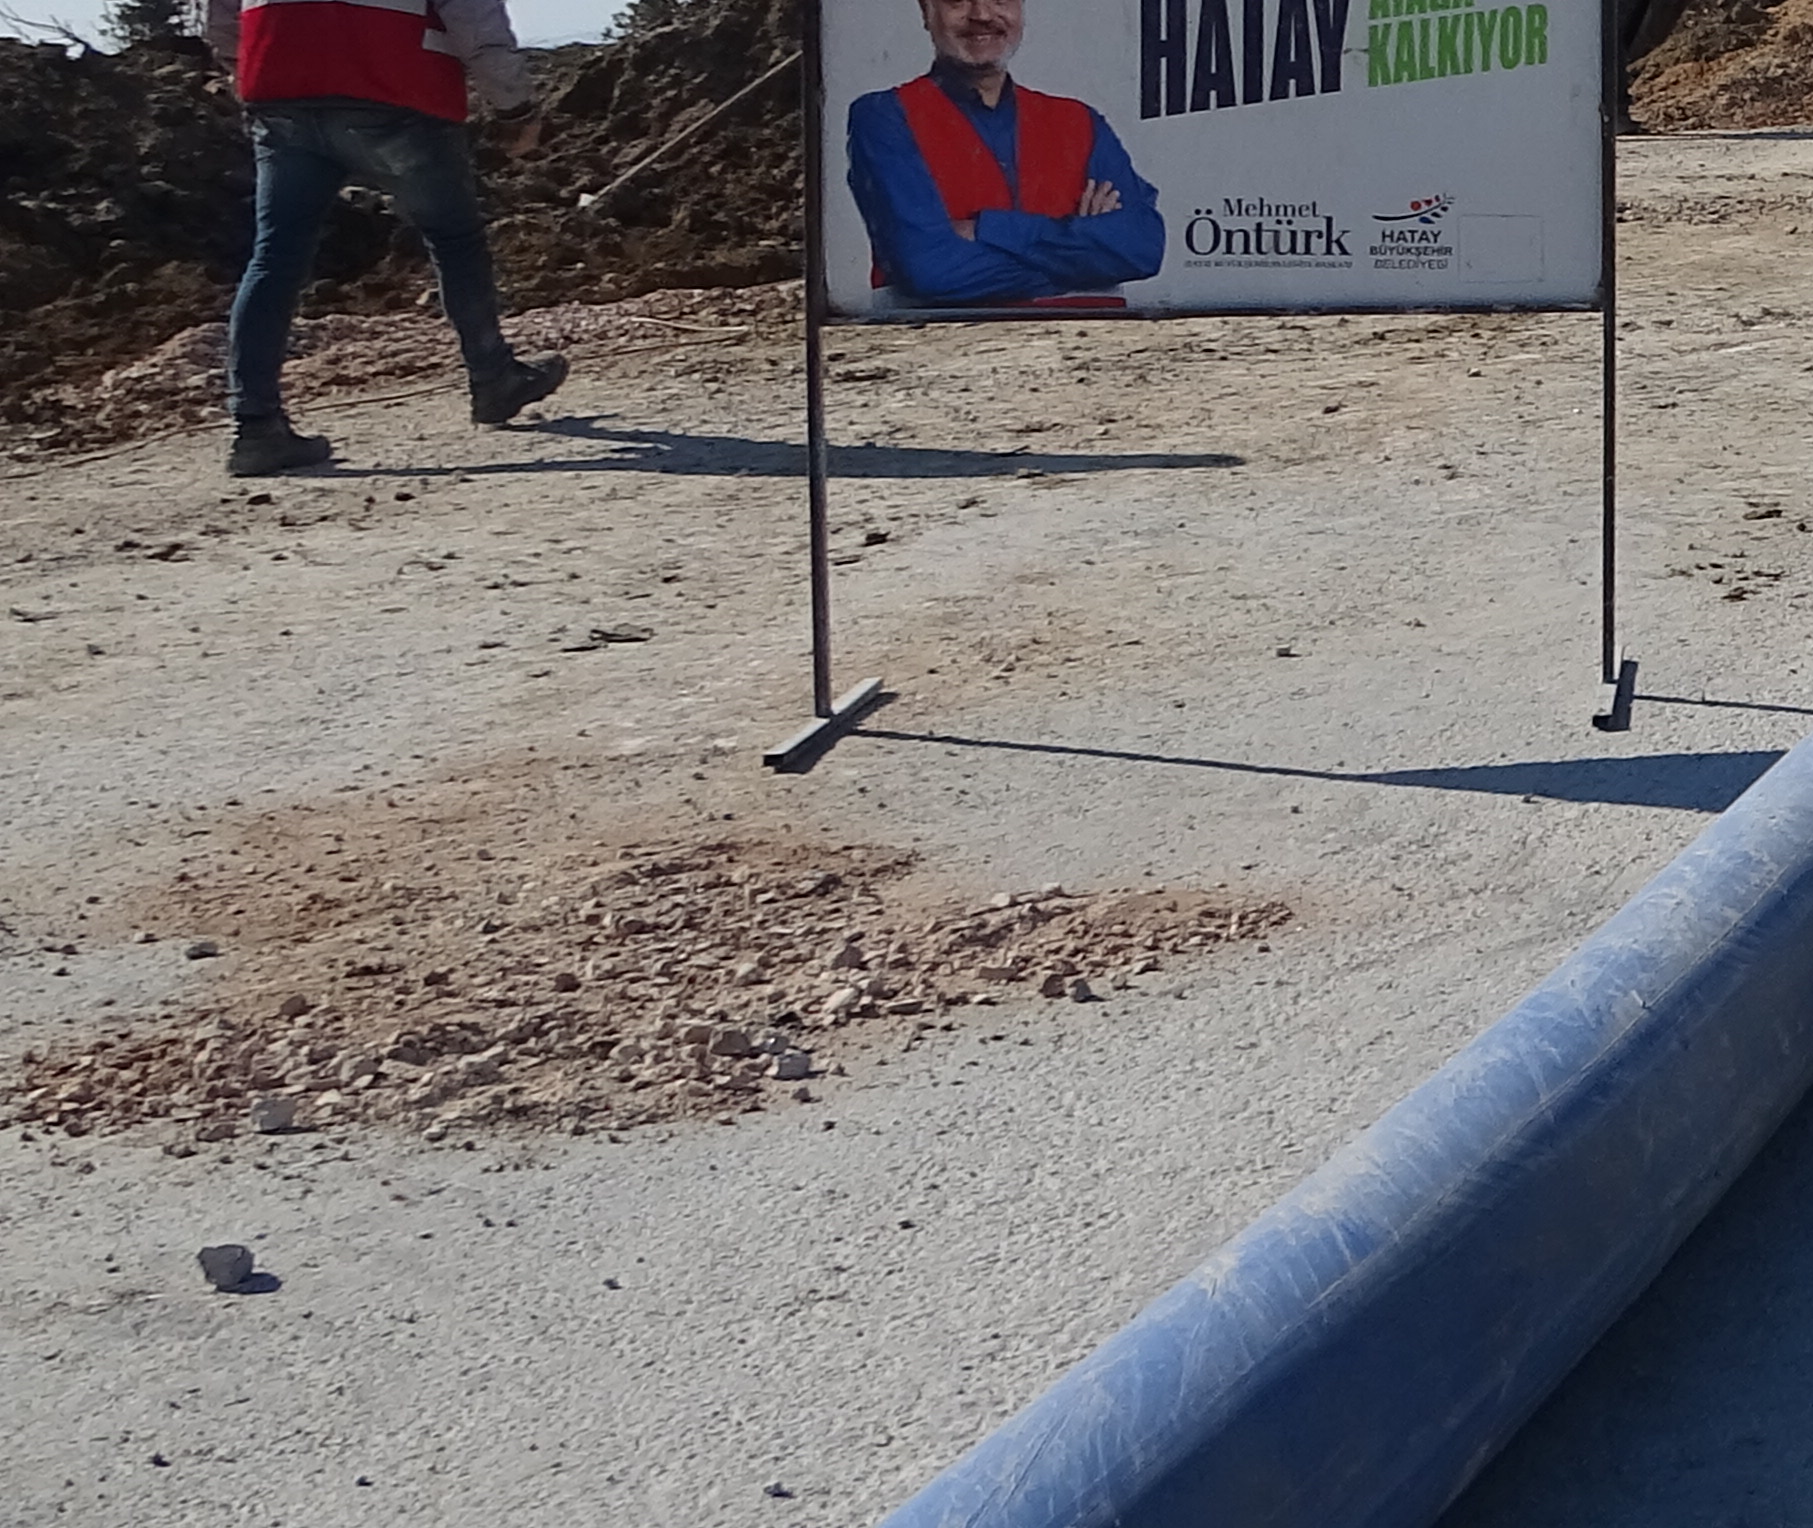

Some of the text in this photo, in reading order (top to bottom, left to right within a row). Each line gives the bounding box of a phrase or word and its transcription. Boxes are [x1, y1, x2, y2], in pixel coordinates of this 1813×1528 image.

[1368, 4, 1548, 88] KALKIYOR
[1222, 197, 1321, 219] Mehmet
[1185, 208, 1352, 257] Öntürk
[1381, 229, 1442, 244] HATAY
